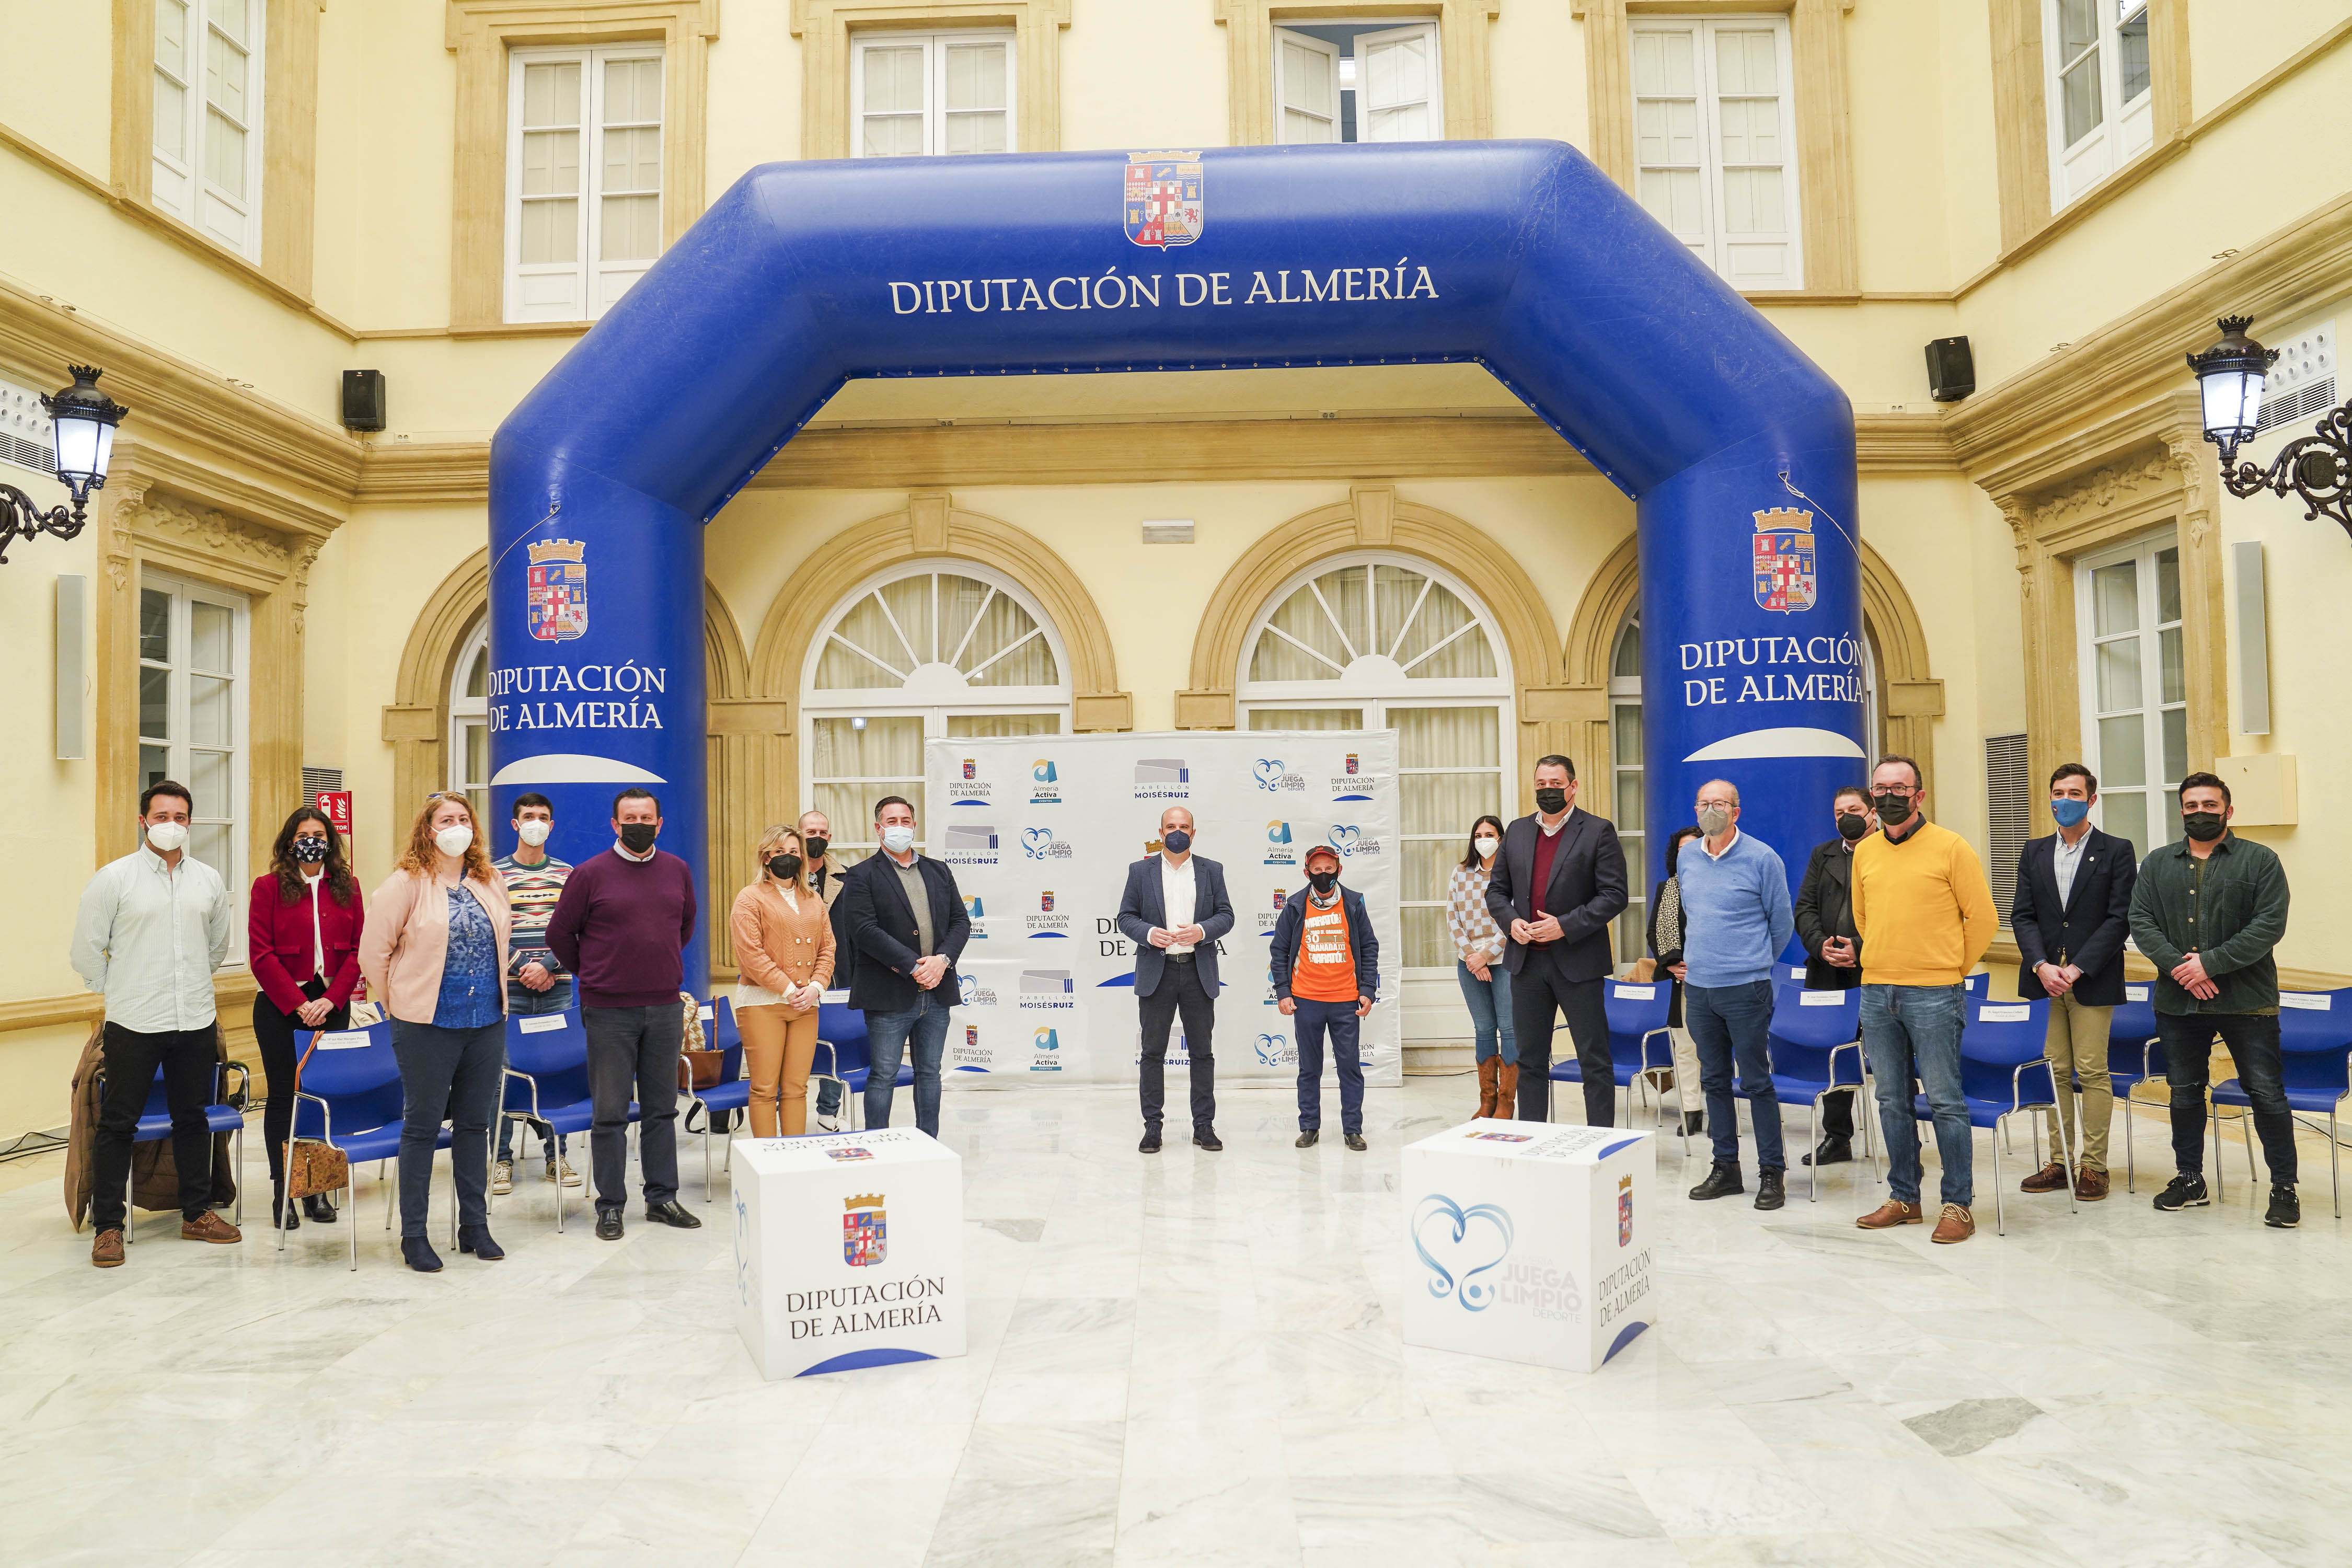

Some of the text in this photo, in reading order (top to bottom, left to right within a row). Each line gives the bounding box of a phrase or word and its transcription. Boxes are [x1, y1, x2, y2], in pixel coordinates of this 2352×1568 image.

[888, 256, 1439, 315] DIPUTACIÓN DE ALMERÍA
[1679, 631, 1864, 671] DIPUTACIÓN
[488, 659, 666, 697] DIPUTACIÓN
[1684, 669, 1864, 706] DE ALMERÍA
[490, 695, 663, 732] DE ALMERÍA
[1331, 776, 1375, 785] DIPUTACIÓN
[1305, 912, 1342, 929] MARATÓN
[1100, 940, 1126, 956] DE
[953, 1047, 993, 1056] DIPUTACIÓN
[1501, 1263, 1579, 1292] JUEGA
[1599, 1247, 1651, 1301] DIPUTACIÓN
[786, 1274, 945, 1312] DIPUTACIÓN
[1501, 1283, 1582, 1312] LIMPIO
[1600, 1274, 1650, 1327] DE ALMERÍA
[790, 1300, 943, 1339] DE ALMERÍA
[1532, 1307, 1582, 1324] DEPORTE
